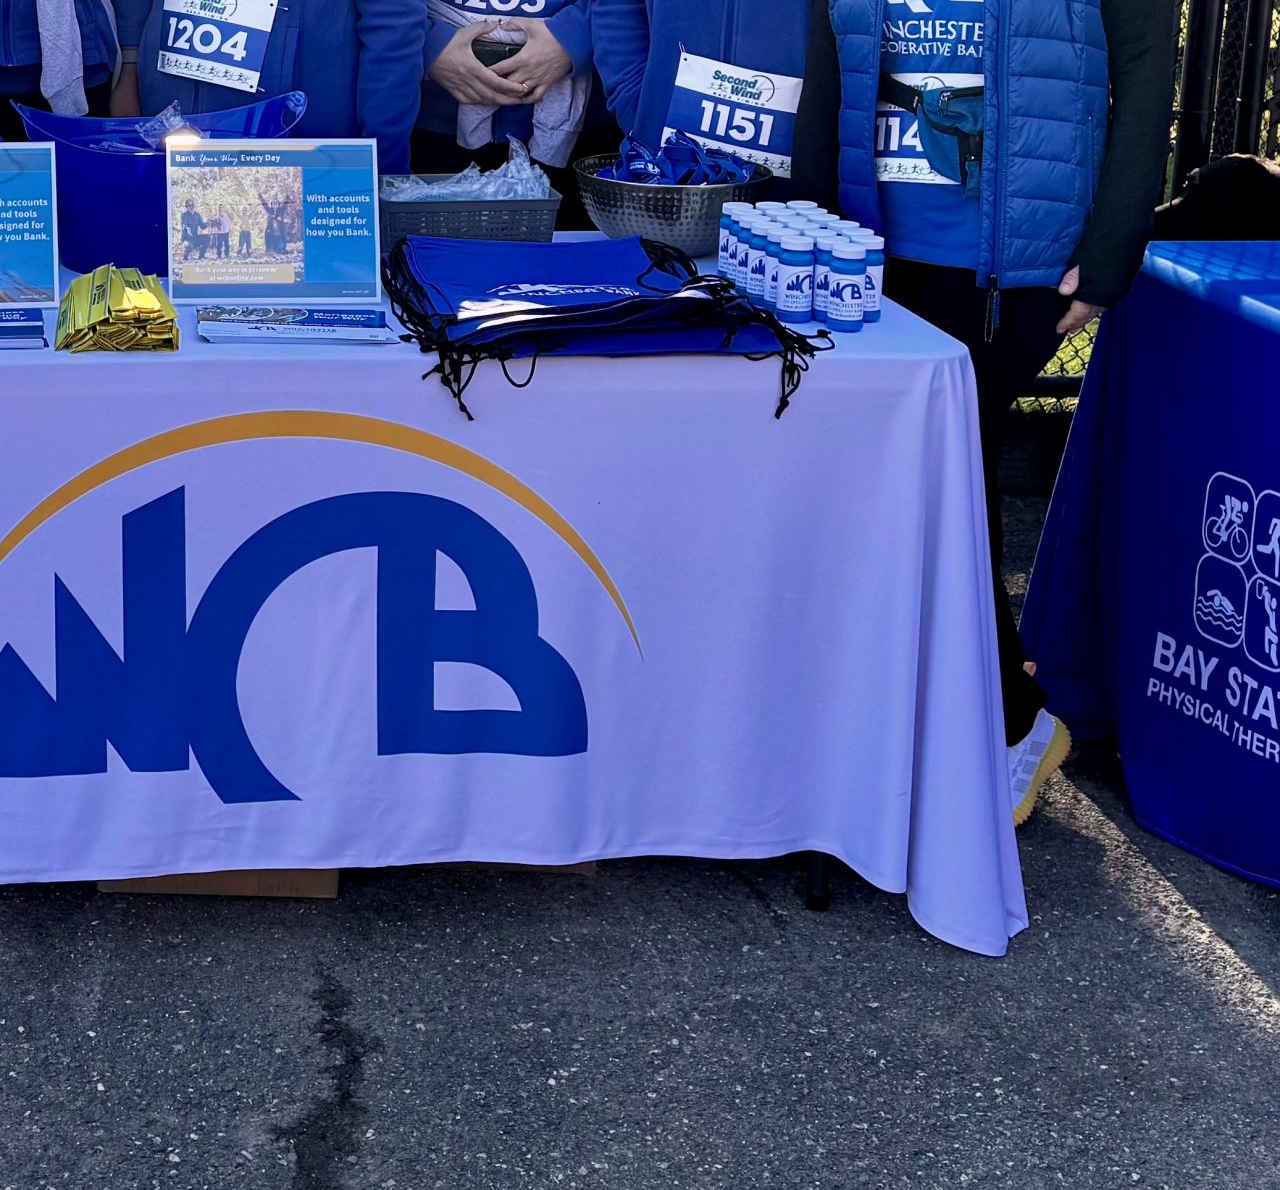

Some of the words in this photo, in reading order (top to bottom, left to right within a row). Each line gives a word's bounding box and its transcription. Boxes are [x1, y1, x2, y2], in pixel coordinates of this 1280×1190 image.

[199, 2, 227, 15] Wind
[167, 17, 248, 61] 1204
[712, 70, 758, 90] Second
[730, 84, 763, 101] Wind
[700, 99, 774, 146] 1151
[877, 117, 924, 152] 114
[175, 154, 196, 162] Bank
[241, 154, 264, 163] Every
[265, 154, 281, 163] Day
[6, 198, 48, 207] accounts
[306, 194, 327, 202] With
[329, 194, 370, 203] accounts
[14, 210, 38, 218] tools
[317, 205, 335, 214] and
[336, 205, 360, 214] tools
[31, 220, 45, 229] for
[310, 216, 352, 227] designed
[353, 216, 367, 225] for
[4, 234, 22, 243] you
[23, 232, 50, 241] Bank.
[306, 227, 325, 236] how
[327, 229, 344, 238] you
[346, 228, 372, 236] Bank.
[1153, 631, 1219, 691] BAY
[1225, 666, 1280, 730] STA
[1147, 678, 1230, 736] PHYSICAL
